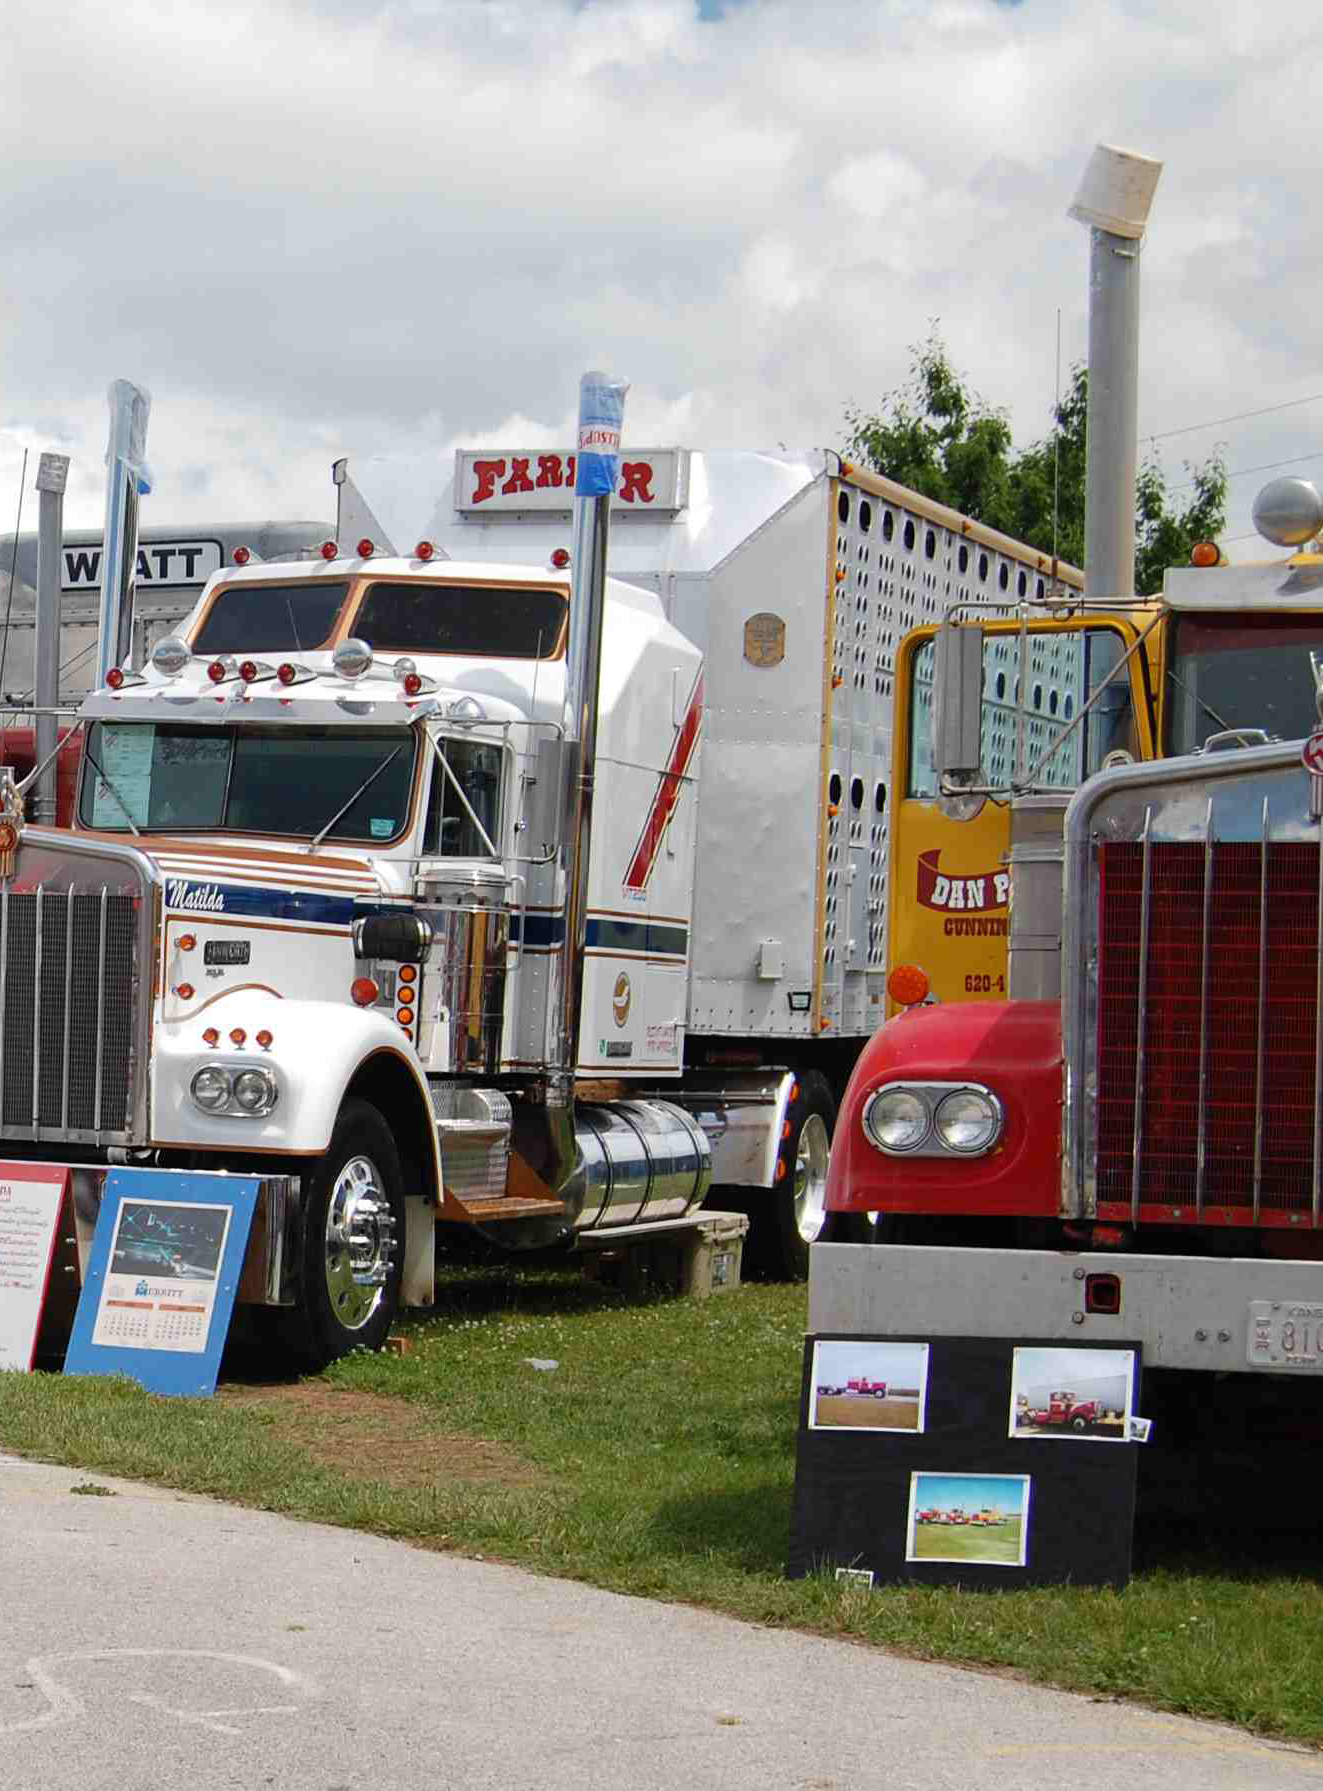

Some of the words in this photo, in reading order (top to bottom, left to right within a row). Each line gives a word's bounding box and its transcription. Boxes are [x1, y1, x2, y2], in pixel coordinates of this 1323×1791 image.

[472, 454, 655, 504] FARR
[65, 548, 203, 582] WATT
[168, 879, 225, 912] Matilda
[931, 876, 985, 909] DAN
[993, 873, 1009, 903] P
[944, 917, 1008, 937] CUNNIN
[964, 974, 1005, 993] 620-4
